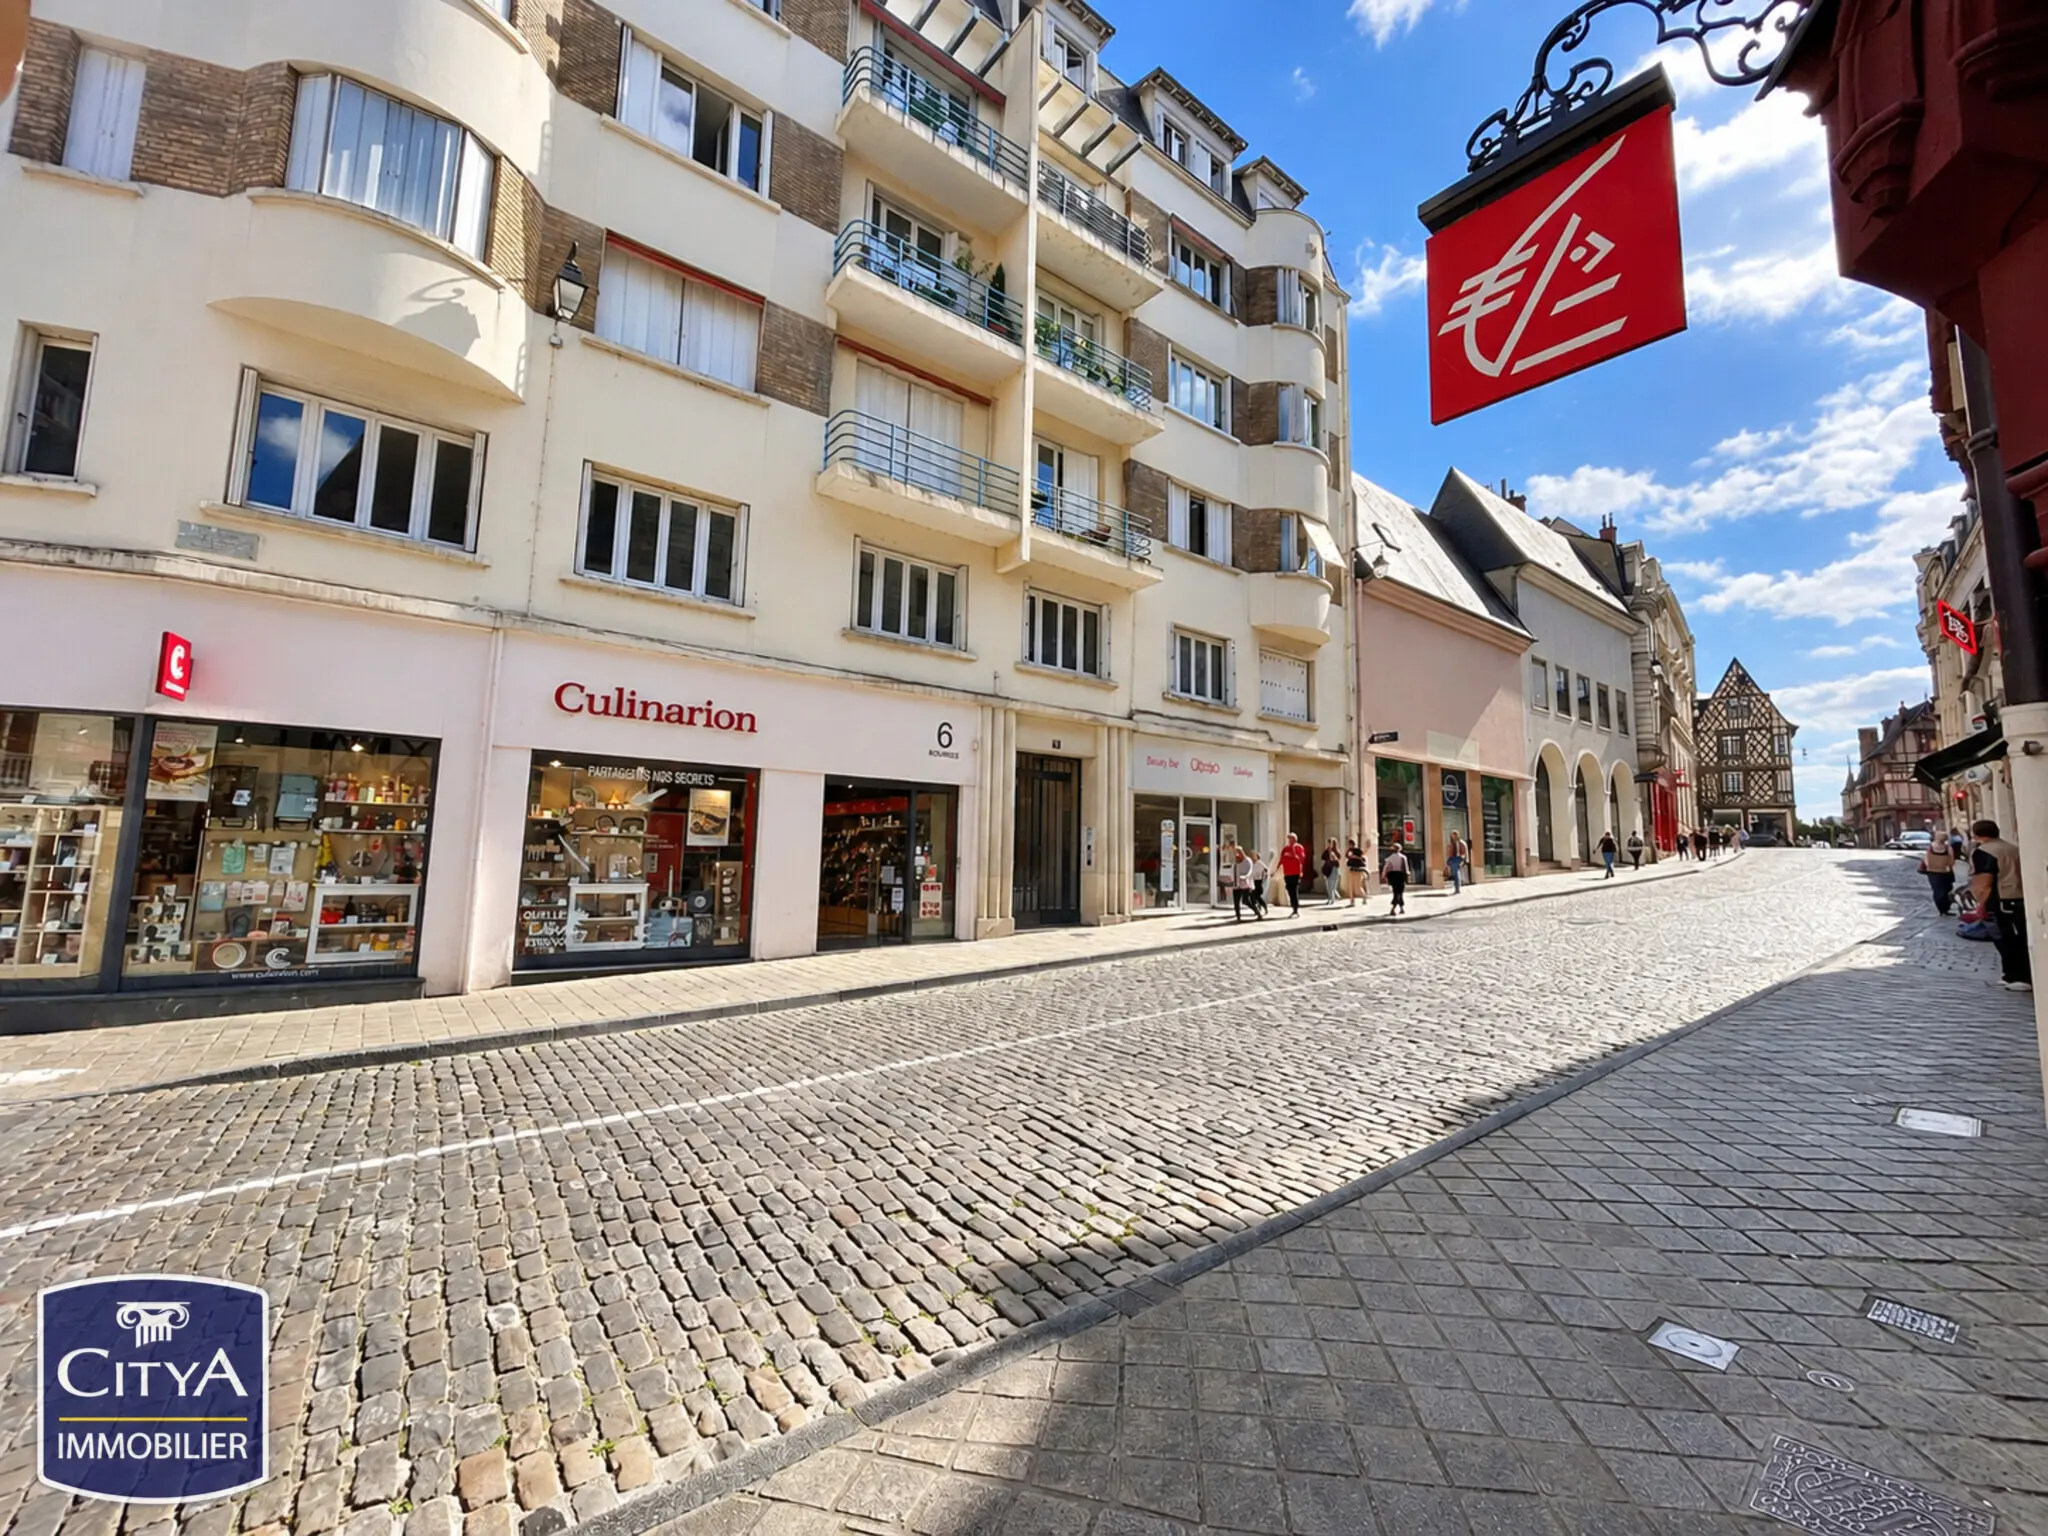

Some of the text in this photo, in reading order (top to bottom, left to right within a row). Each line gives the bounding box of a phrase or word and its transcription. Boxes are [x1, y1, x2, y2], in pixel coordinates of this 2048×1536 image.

[553, 682, 758, 733] Culinarion
[937, 721, 953, 749] 6
[652, 770, 673, 783] NOS
[674, 771, 715, 786] SECRETS
